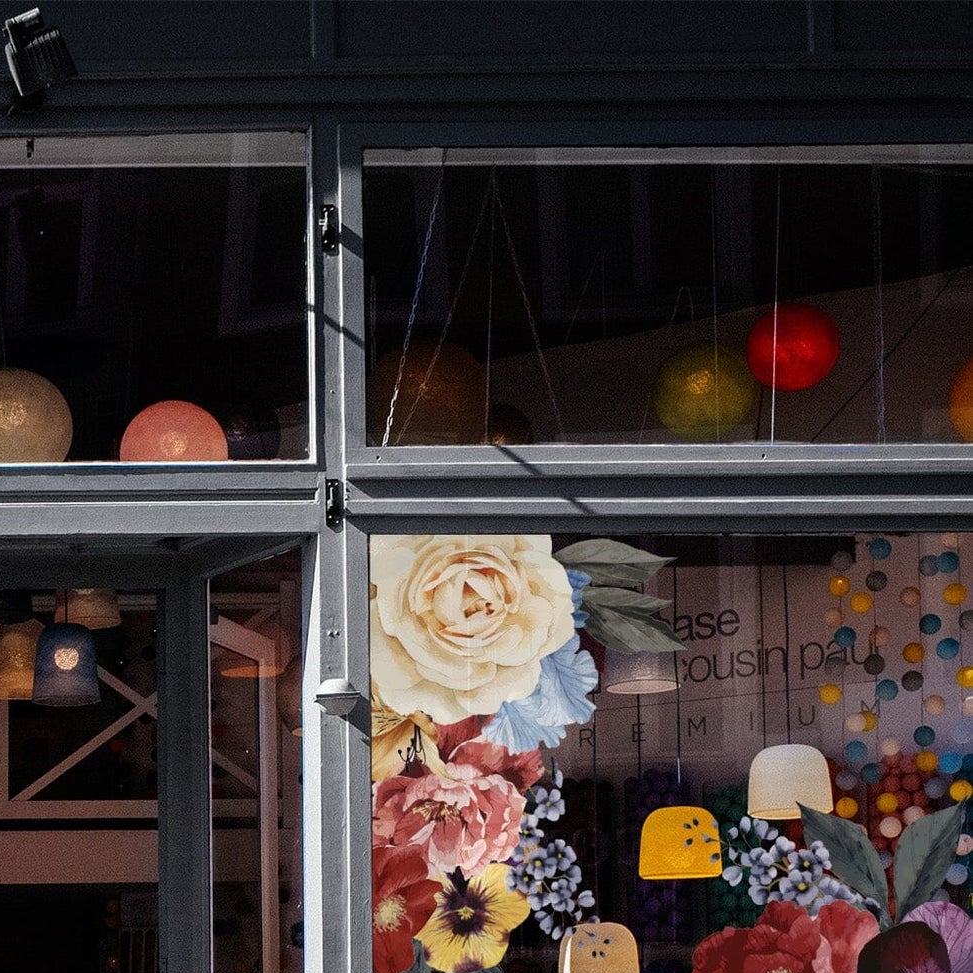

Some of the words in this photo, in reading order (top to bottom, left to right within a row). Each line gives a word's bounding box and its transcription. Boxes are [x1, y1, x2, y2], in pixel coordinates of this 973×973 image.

[657, 609, 740, 642] ase
[682, 637, 787, 683] ousin
[578, 699, 881, 748] REMIUM
